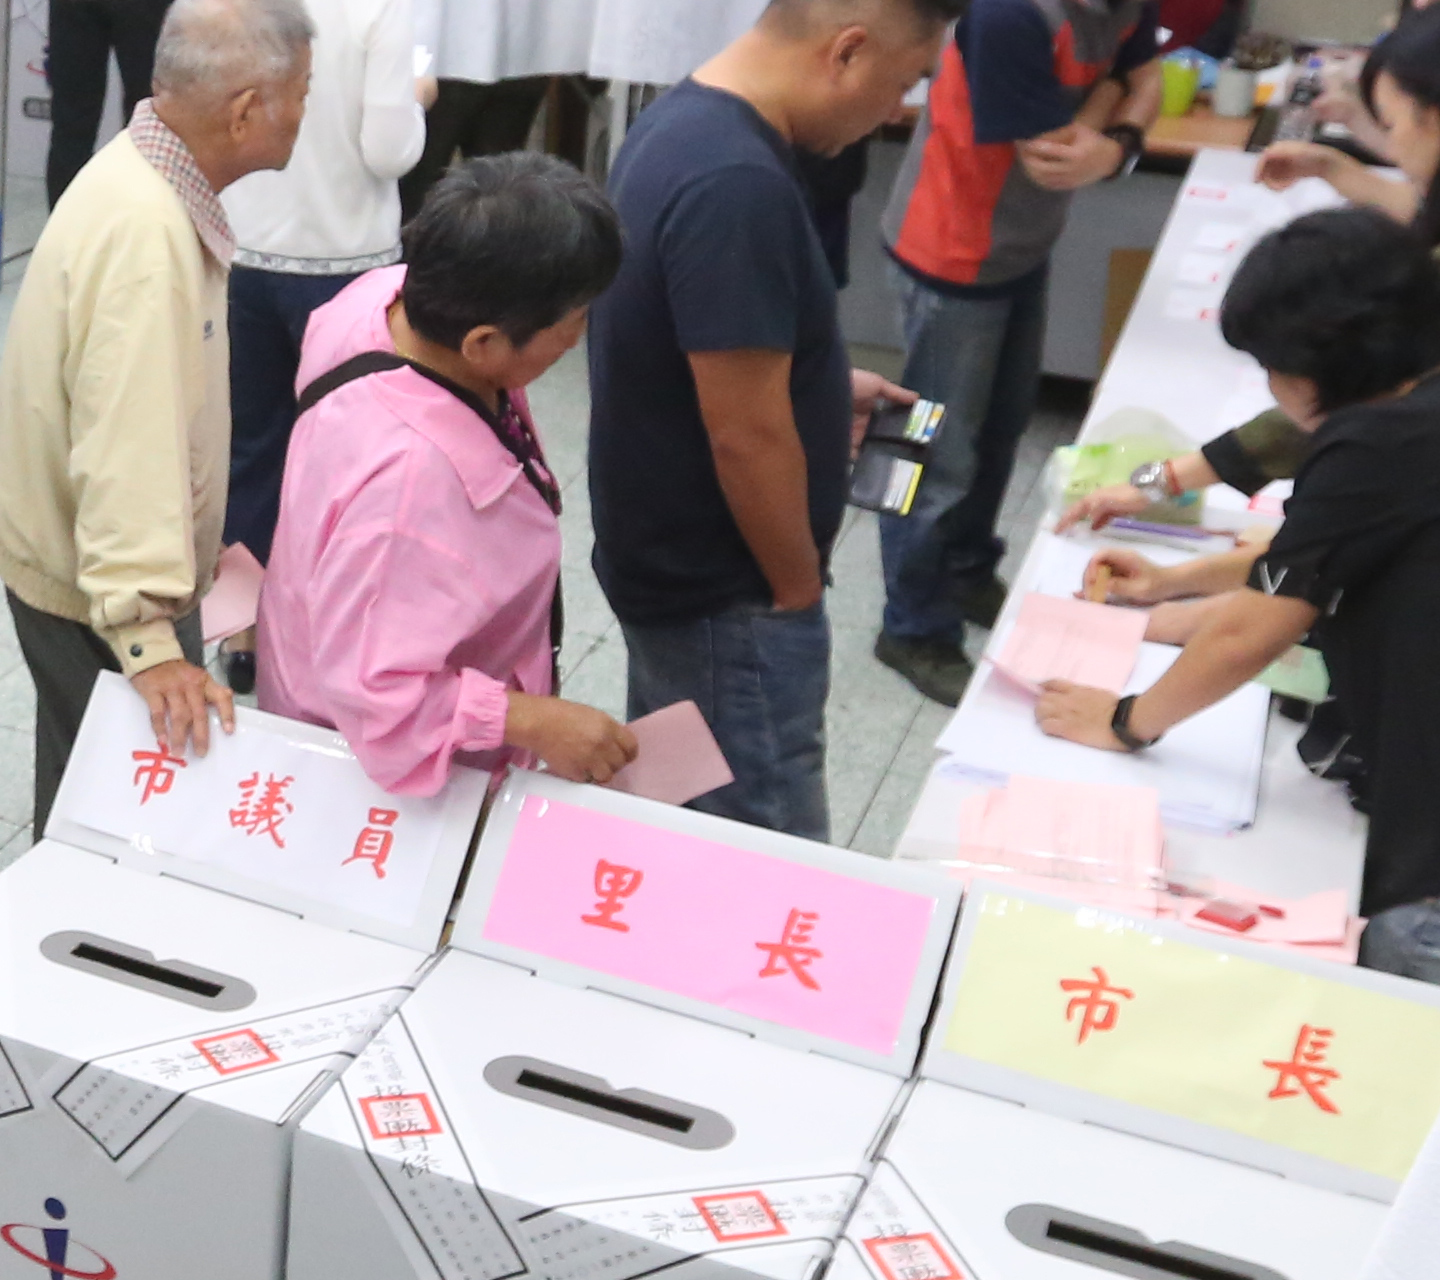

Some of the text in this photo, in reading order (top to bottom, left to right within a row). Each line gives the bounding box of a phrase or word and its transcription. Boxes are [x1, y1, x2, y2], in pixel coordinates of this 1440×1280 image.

[132, 739, 399, 879] 市議員
[580, 858, 824, 991] 里長
[1059, 965, 1344, 1116] 市長
